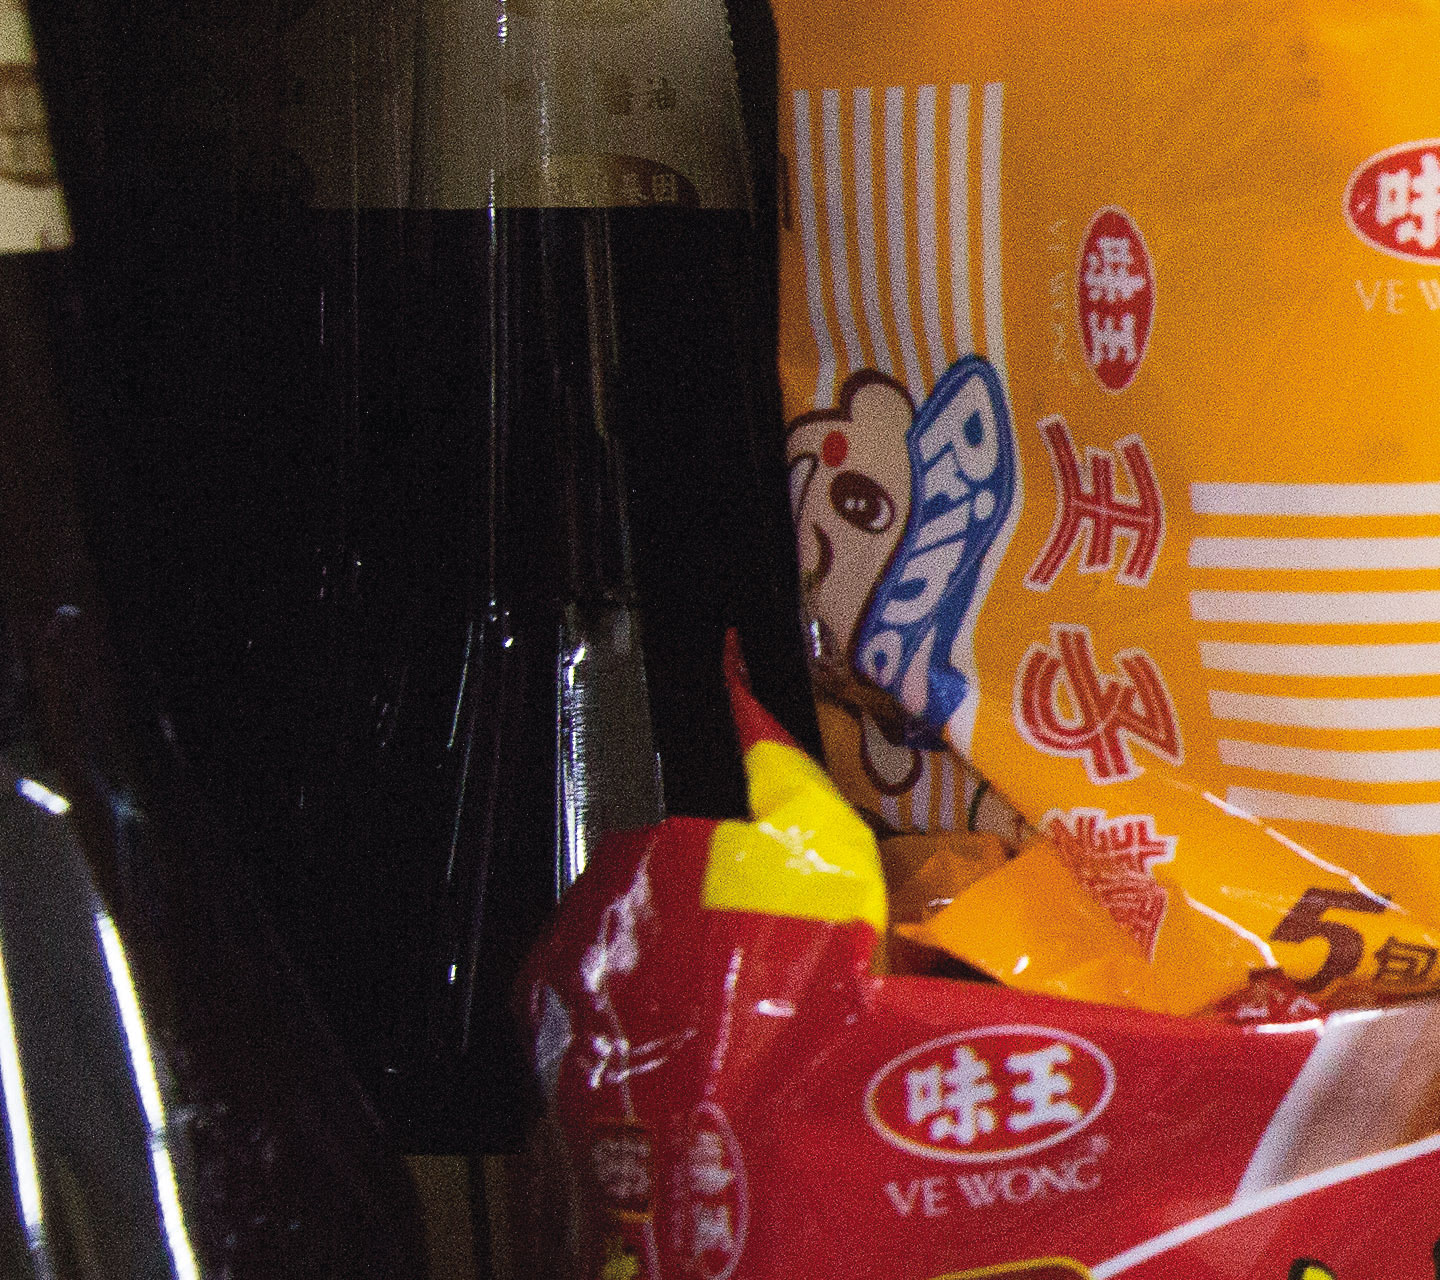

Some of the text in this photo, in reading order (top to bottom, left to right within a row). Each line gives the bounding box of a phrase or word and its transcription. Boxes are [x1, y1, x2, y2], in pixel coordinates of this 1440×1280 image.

[906, 1045, 1083, 1146] 味王
[885, 1158, 1102, 1218] VE WONG
